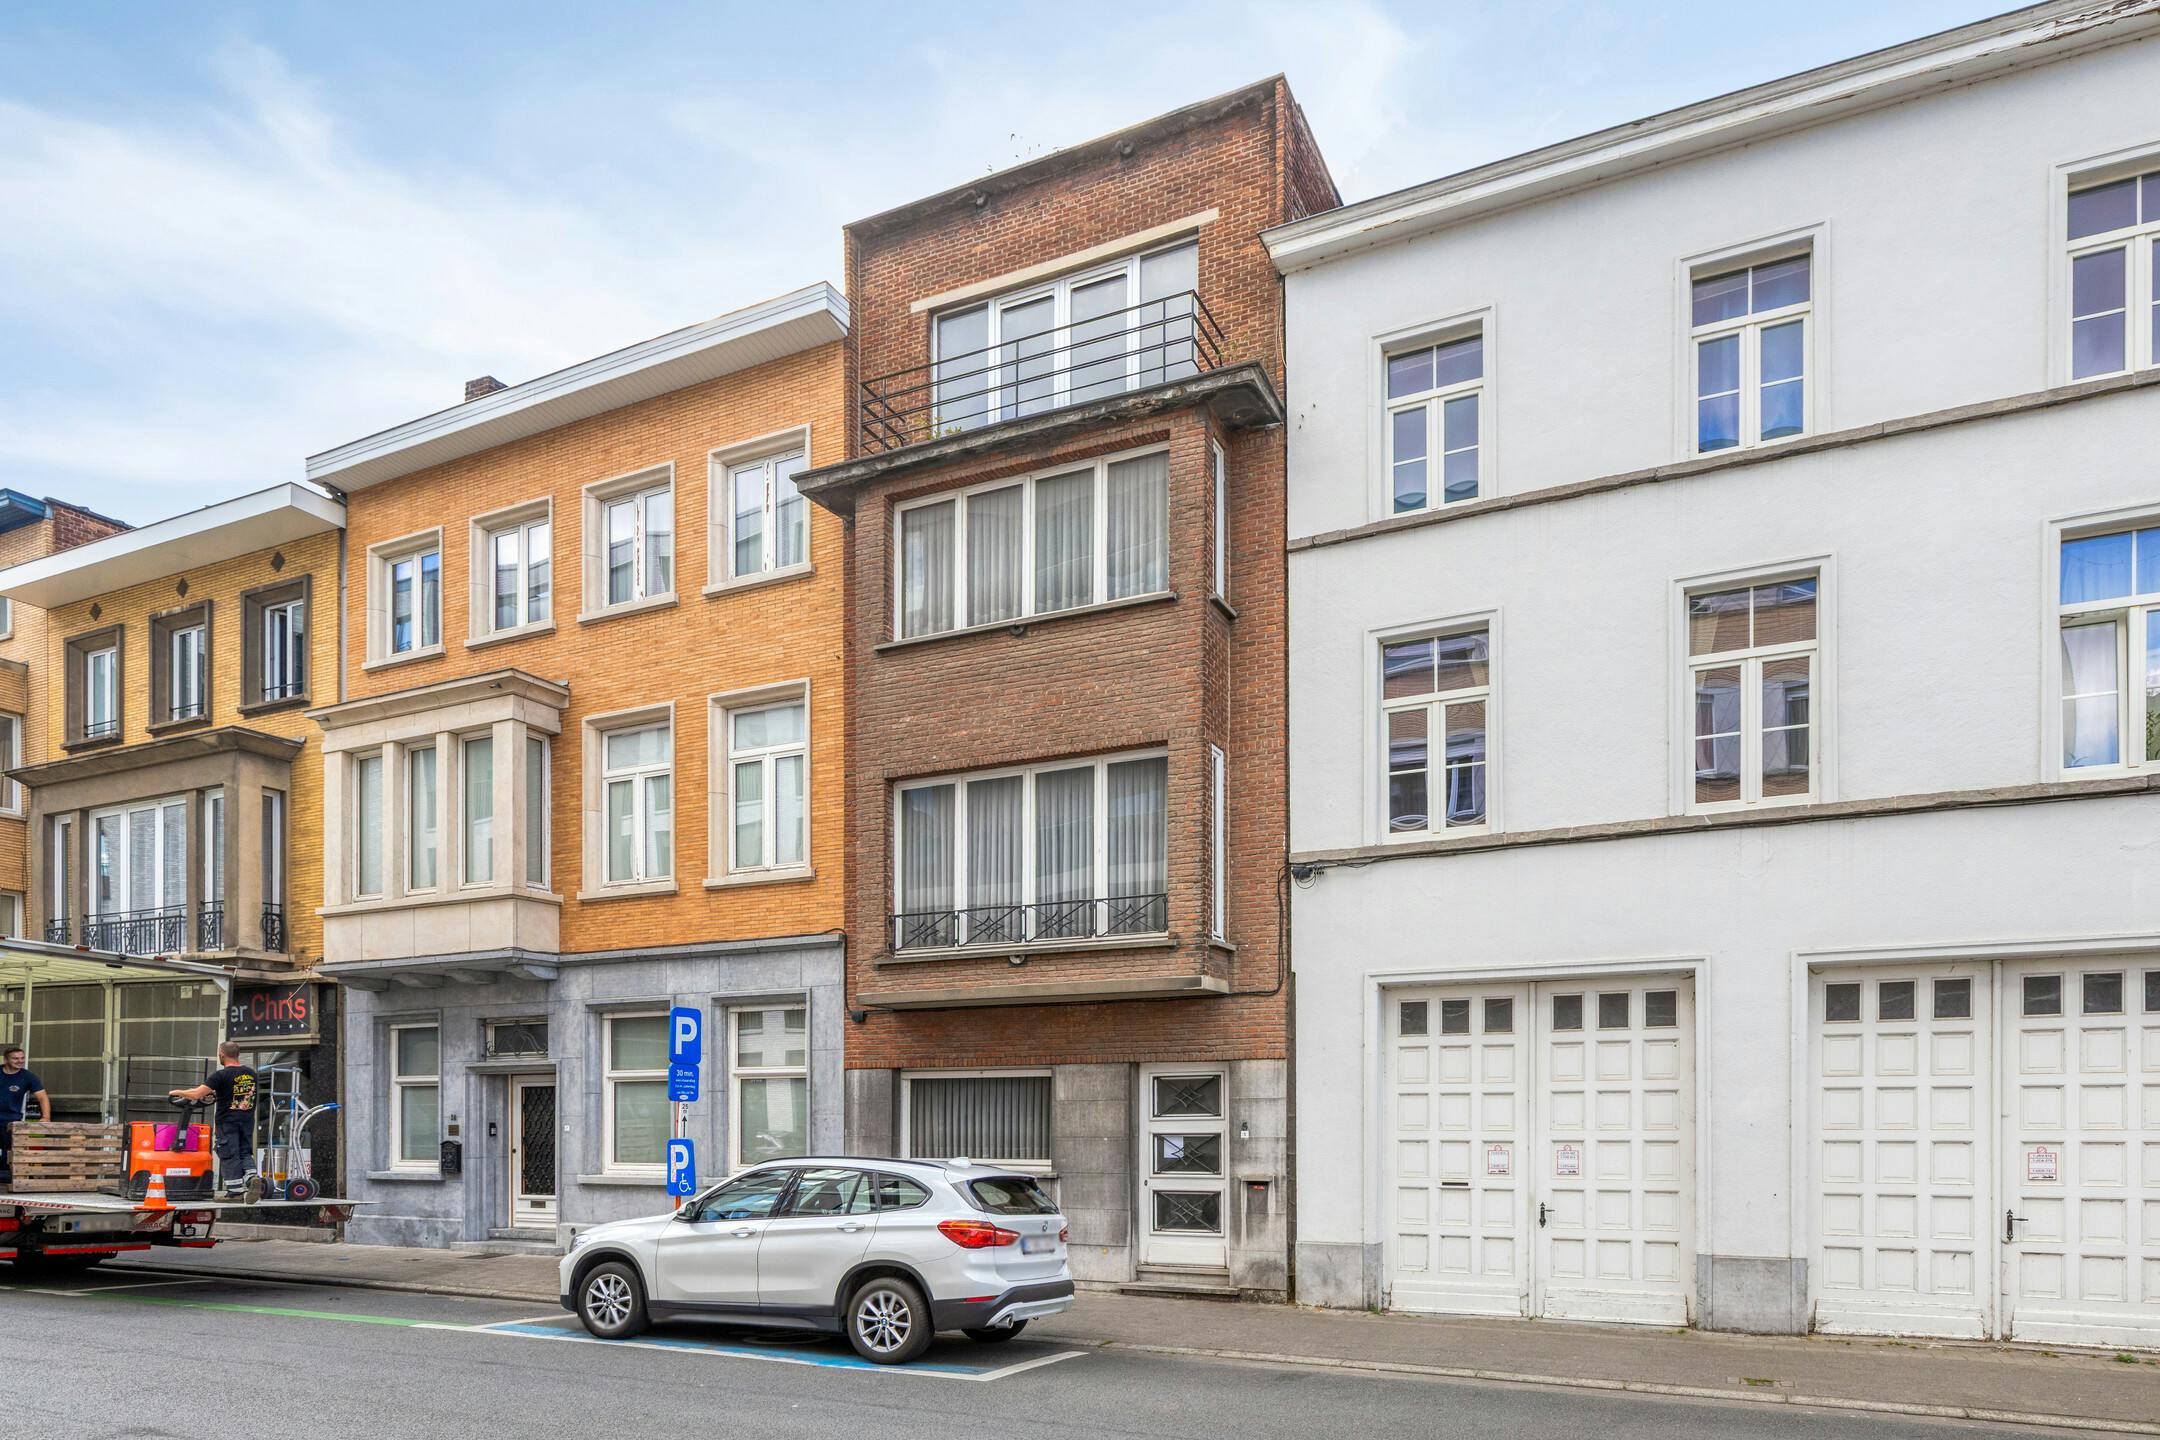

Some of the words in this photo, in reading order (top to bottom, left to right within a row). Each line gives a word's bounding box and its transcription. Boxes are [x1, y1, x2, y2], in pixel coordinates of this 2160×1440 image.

[251, 991, 306, 1021] Chris
[676, 1016, 697, 1055] P
[677, 1069, 683, 1077] 30
[671, 1144, 689, 1182] P
